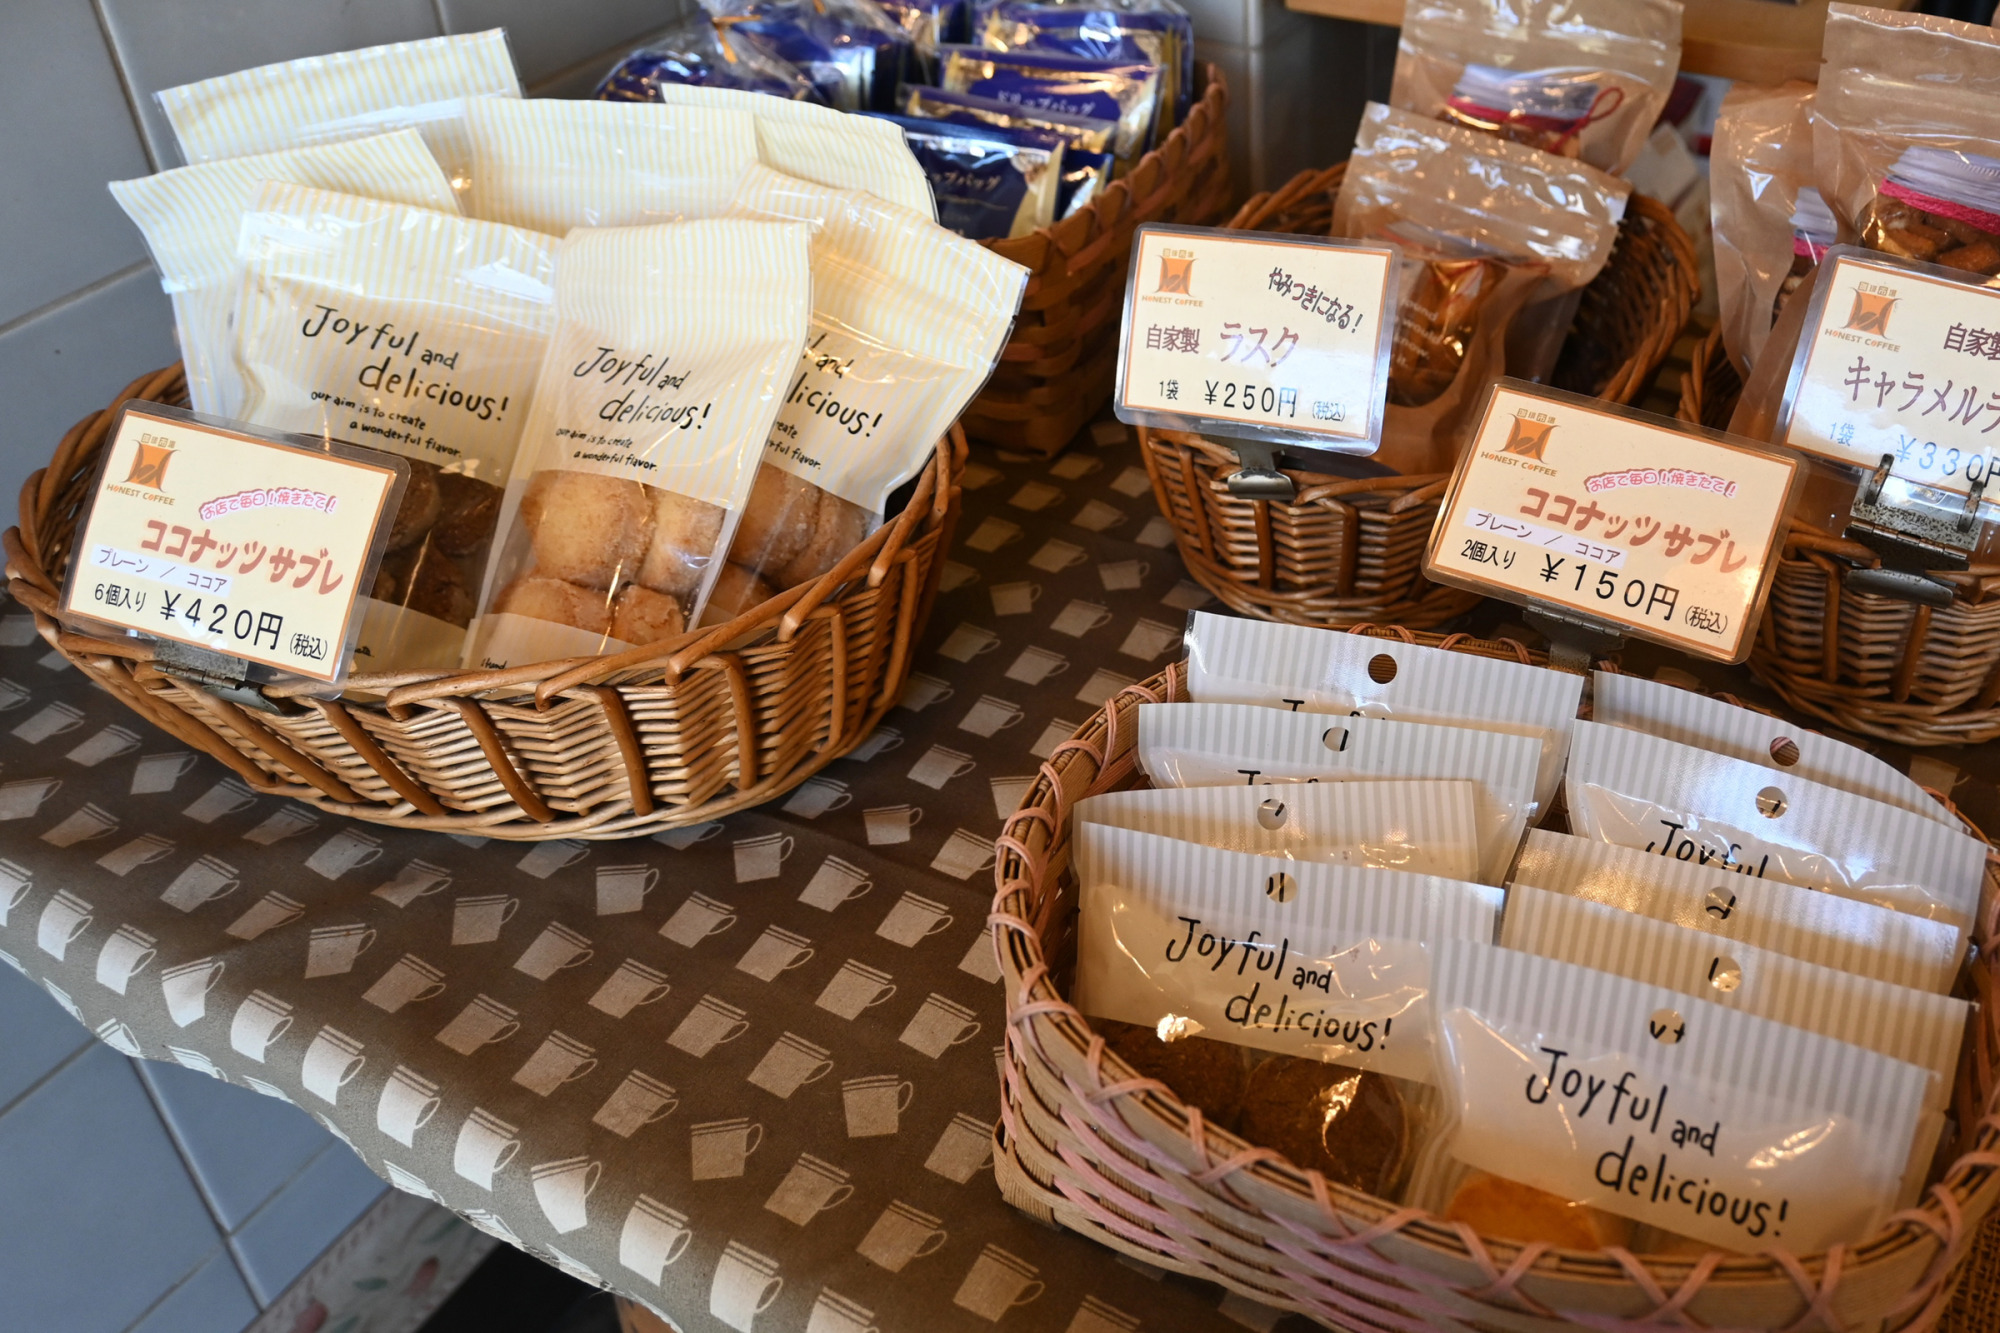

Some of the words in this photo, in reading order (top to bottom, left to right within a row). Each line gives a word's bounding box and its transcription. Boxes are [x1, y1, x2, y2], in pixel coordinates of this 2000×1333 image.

[1175, 298, 1204, 307] COFFEE
[302, 304, 419, 356] Joyful
[421, 349, 459, 370] and
[1146, 324, 1200, 354] 自家製
[1220, 322, 1299, 368] ラスク
[1824, 328, 1862, 343] HONEST
[1864, 338, 1901, 352] COFFEE
[358, 356, 509, 421] delicious!
[574, 347, 669, 386] Joyful
[657, 371, 691, 391] and
[1159, 379, 1178, 400] 1袋
[310, 391, 331, 401] our
[333, 394, 355, 408] aim
[359, 403, 370, 414] is
[388, 412, 426, 430] create
[599, 389, 711, 430] delicious!
[786, 371, 882, 438] licious!
[349, 420, 358, 430] a
[361, 422, 421, 446] wonderful
[425, 437, 462, 458] flavor.
[1829, 421, 1855, 447] 1袋
[582, 452, 624, 464] wonderful
[1481, 451, 1519, 466] HONEST
[1521, 462, 1557, 477] COFFEE
[106, 483, 141, 497] HONEST
[142, 492, 175, 505] COFFEE
[1475, 512, 1532, 538] プレーン
[1575, 542, 1621, 563] ココア
[1520, 488, 1747, 573] ココナッツサブレ
[99, 548, 149, 573] プレーン
[187, 573, 228, 593] ココア
[141, 520, 344, 596] ココナッツサブレ
[1461, 539, 1516, 570] 2個入り
[94, 583, 147, 612] 6個入り
[1165, 916, 1289, 980] Joyful
[1293, 965, 1333, 994] and
[1225, 981, 1392, 1053] delicious!
[1525, 1046, 1669, 1134] Joyful
[1672, 1119, 1720, 1156] and
[1594, 1135, 1790, 1238] delicious!
